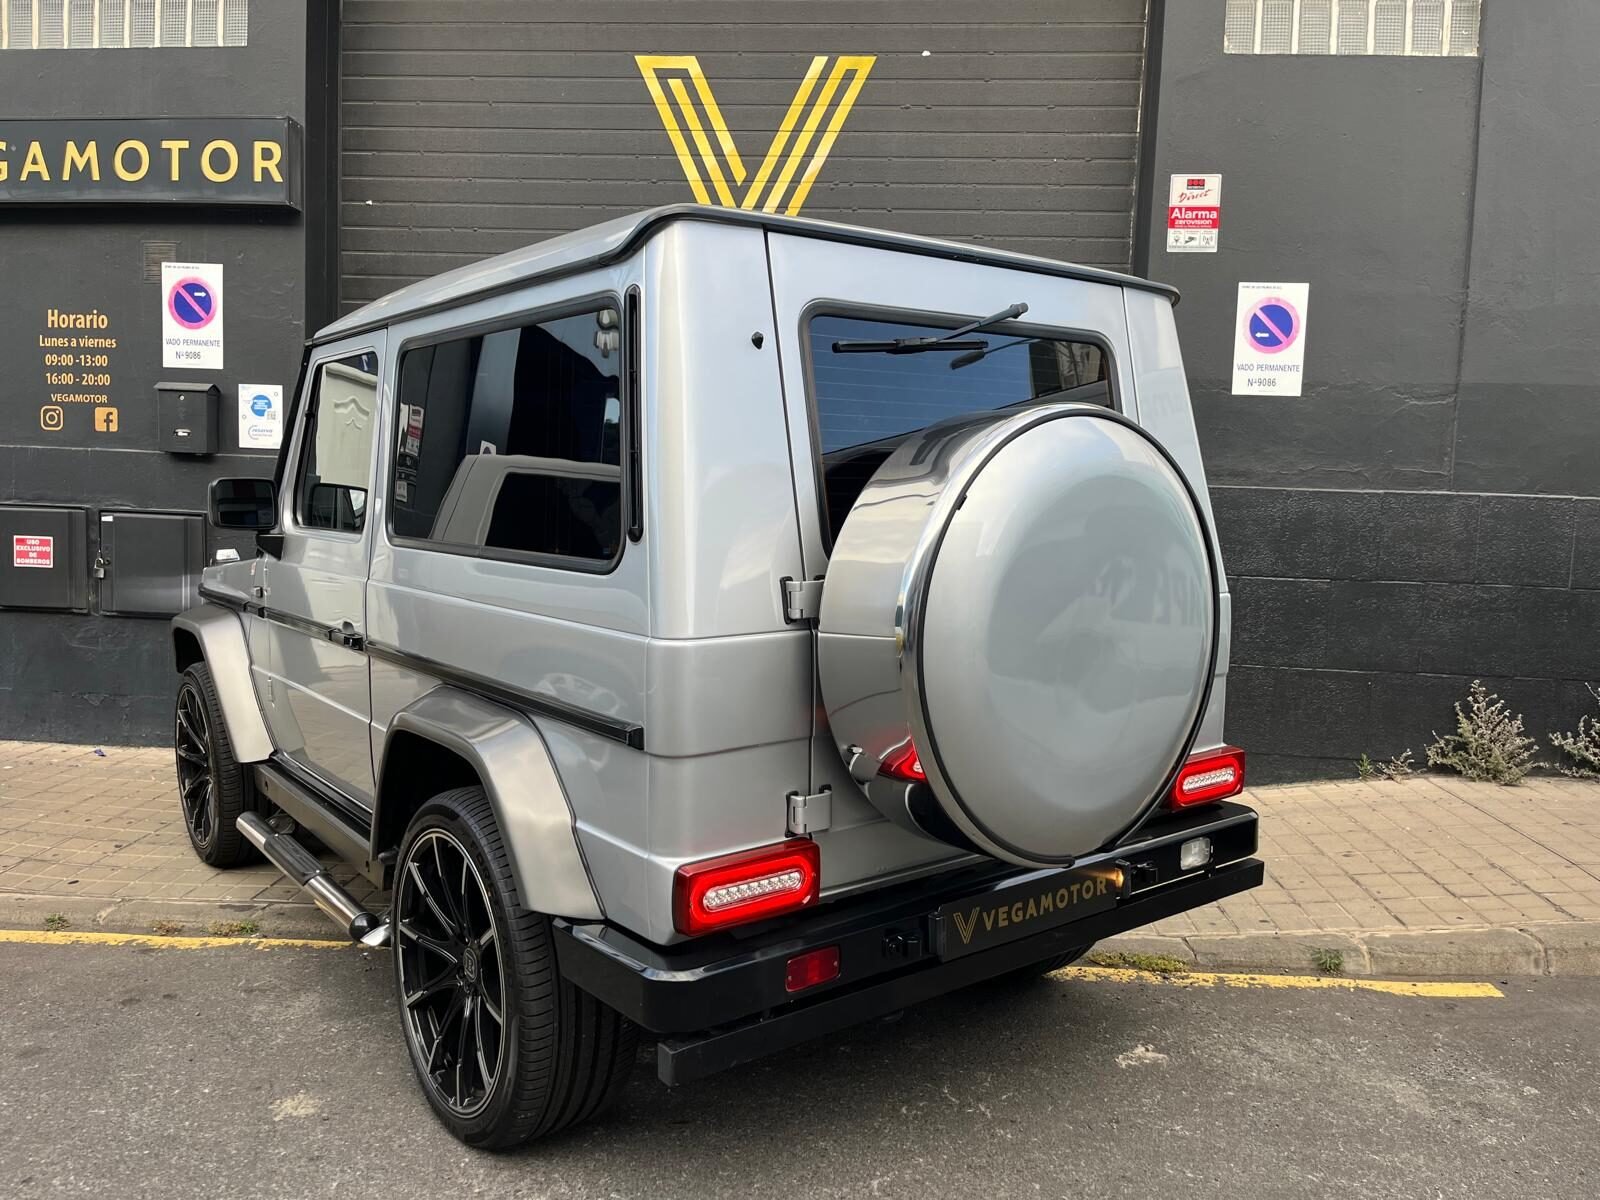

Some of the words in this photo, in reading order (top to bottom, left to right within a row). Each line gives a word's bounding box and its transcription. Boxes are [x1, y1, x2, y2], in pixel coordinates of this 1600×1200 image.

[0, 139, 284, 183] AMOTOR
[1171, 208, 1217, 219] Alarma
[47, 309, 108, 329] Horario
[39, 335, 68, 347] Lunes
[70, 339, 77, 347] a
[79, 336, 117, 348] viernes
[166, 338, 181, 346] VADO
[182, 339, 221, 347] PERMANENTE
[45, 354, 73, 366] 09:00
[1256, 364, 1300, 373] PERMANENTE
[45, 373, 73, 385] 16:00
[81, 374, 111, 386] 20:00
[51, 394, 108, 403] VEGAMOTOR
[982, 877, 1107, 931] VEGAMOTOR
